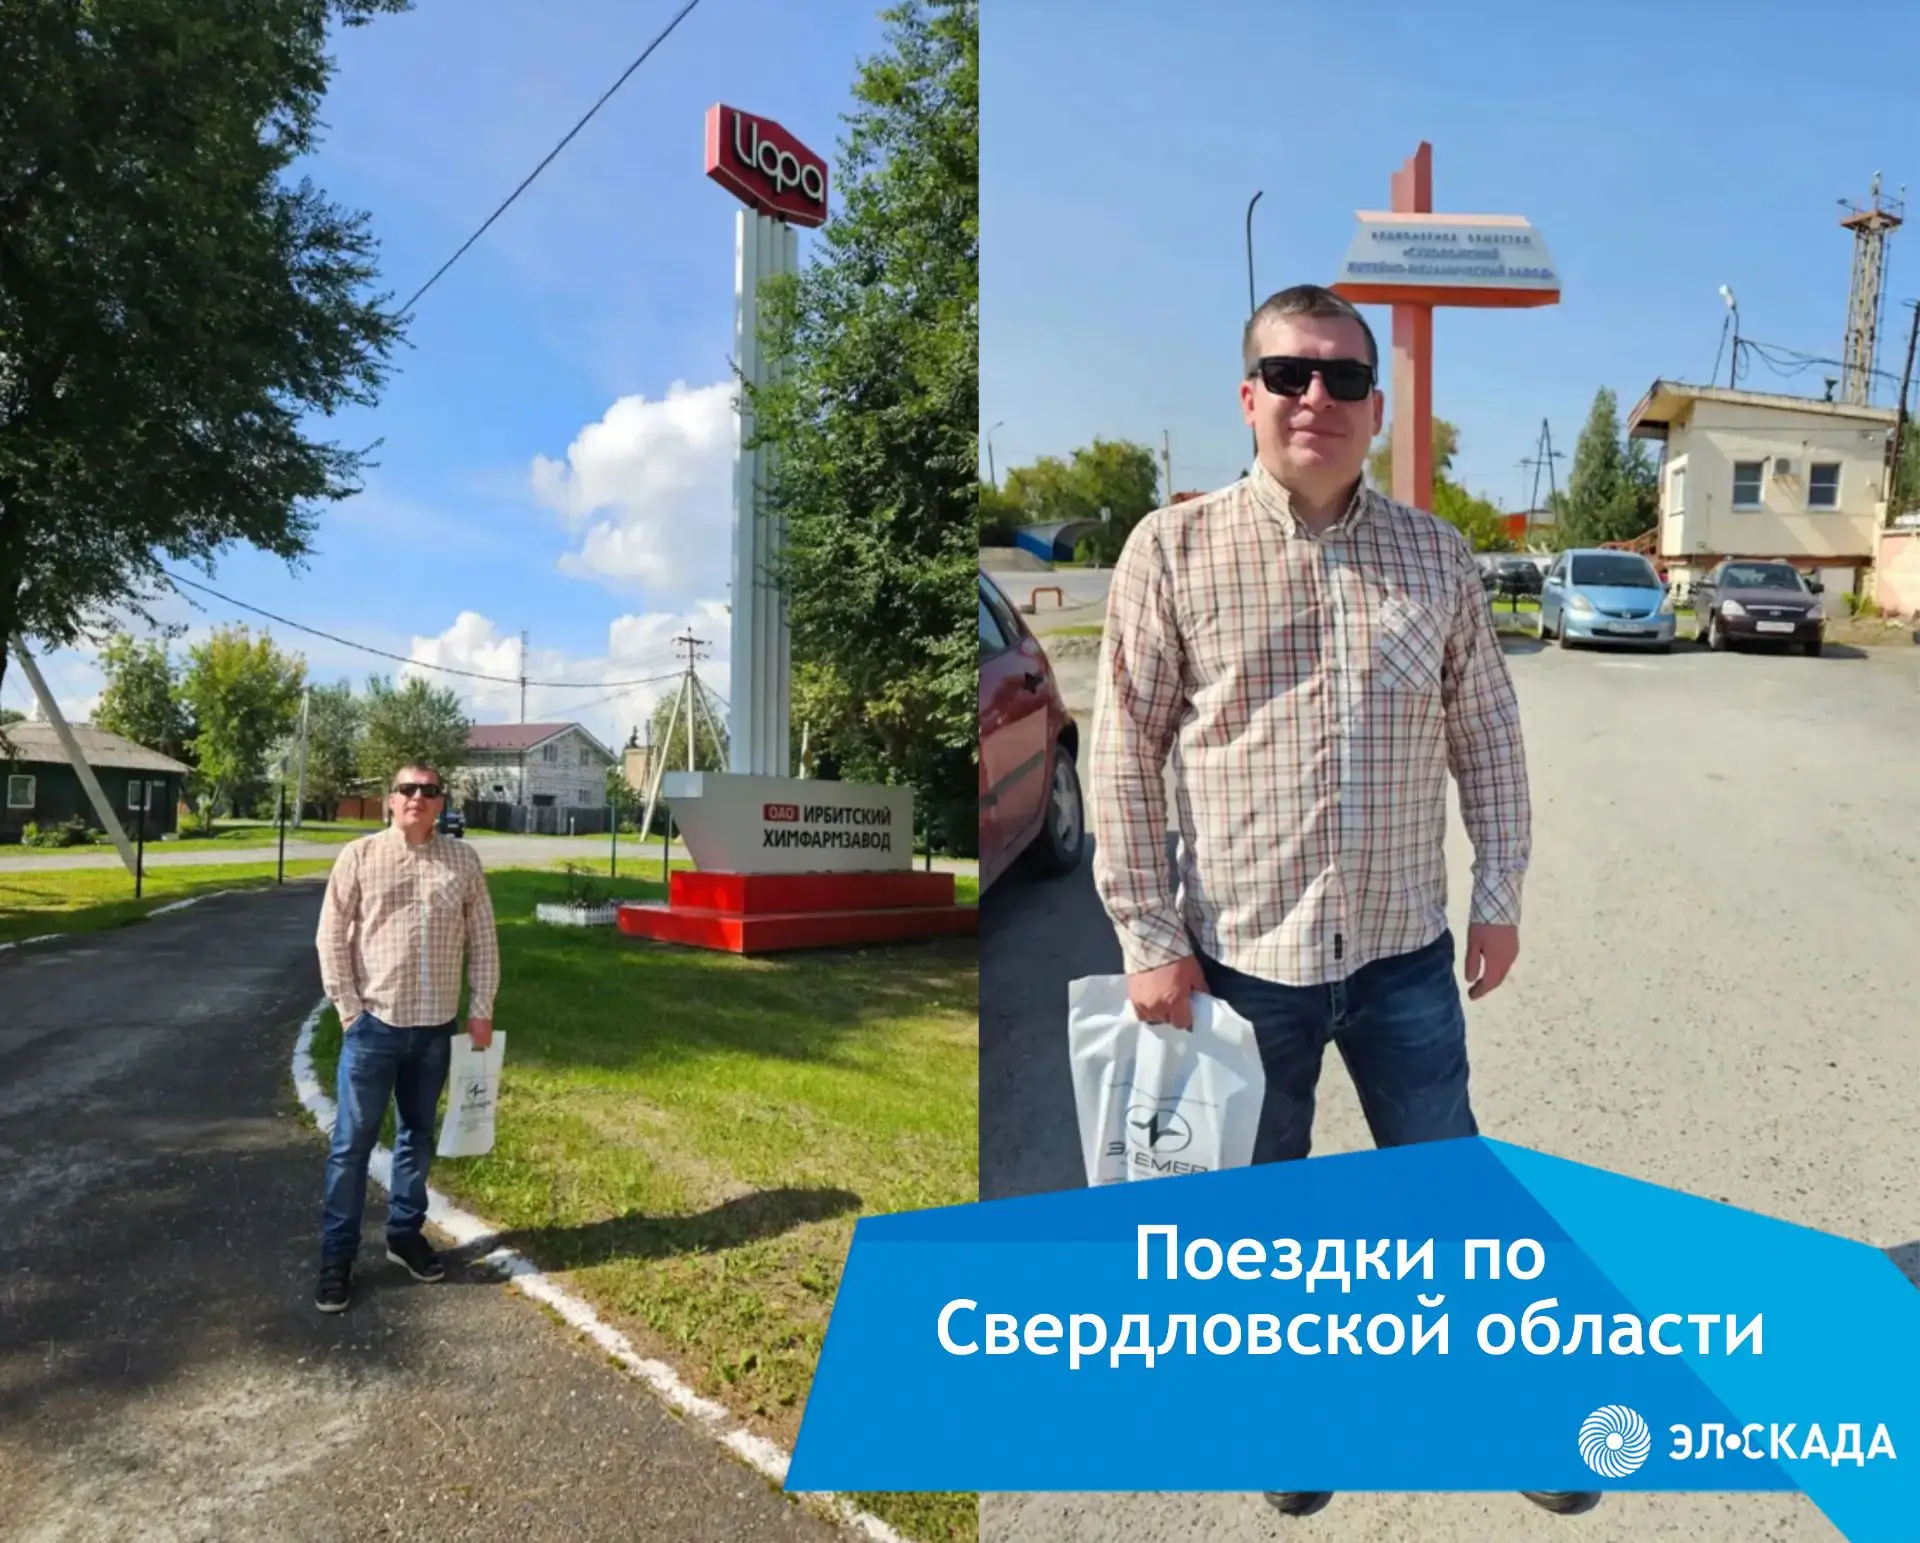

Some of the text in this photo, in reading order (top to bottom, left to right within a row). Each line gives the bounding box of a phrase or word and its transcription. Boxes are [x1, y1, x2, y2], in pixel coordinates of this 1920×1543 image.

[769, 804, 891, 825] ОАО ИРБИТСКИЙ
[762, 828, 891, 852] ХИМФАРМЗАВОД
